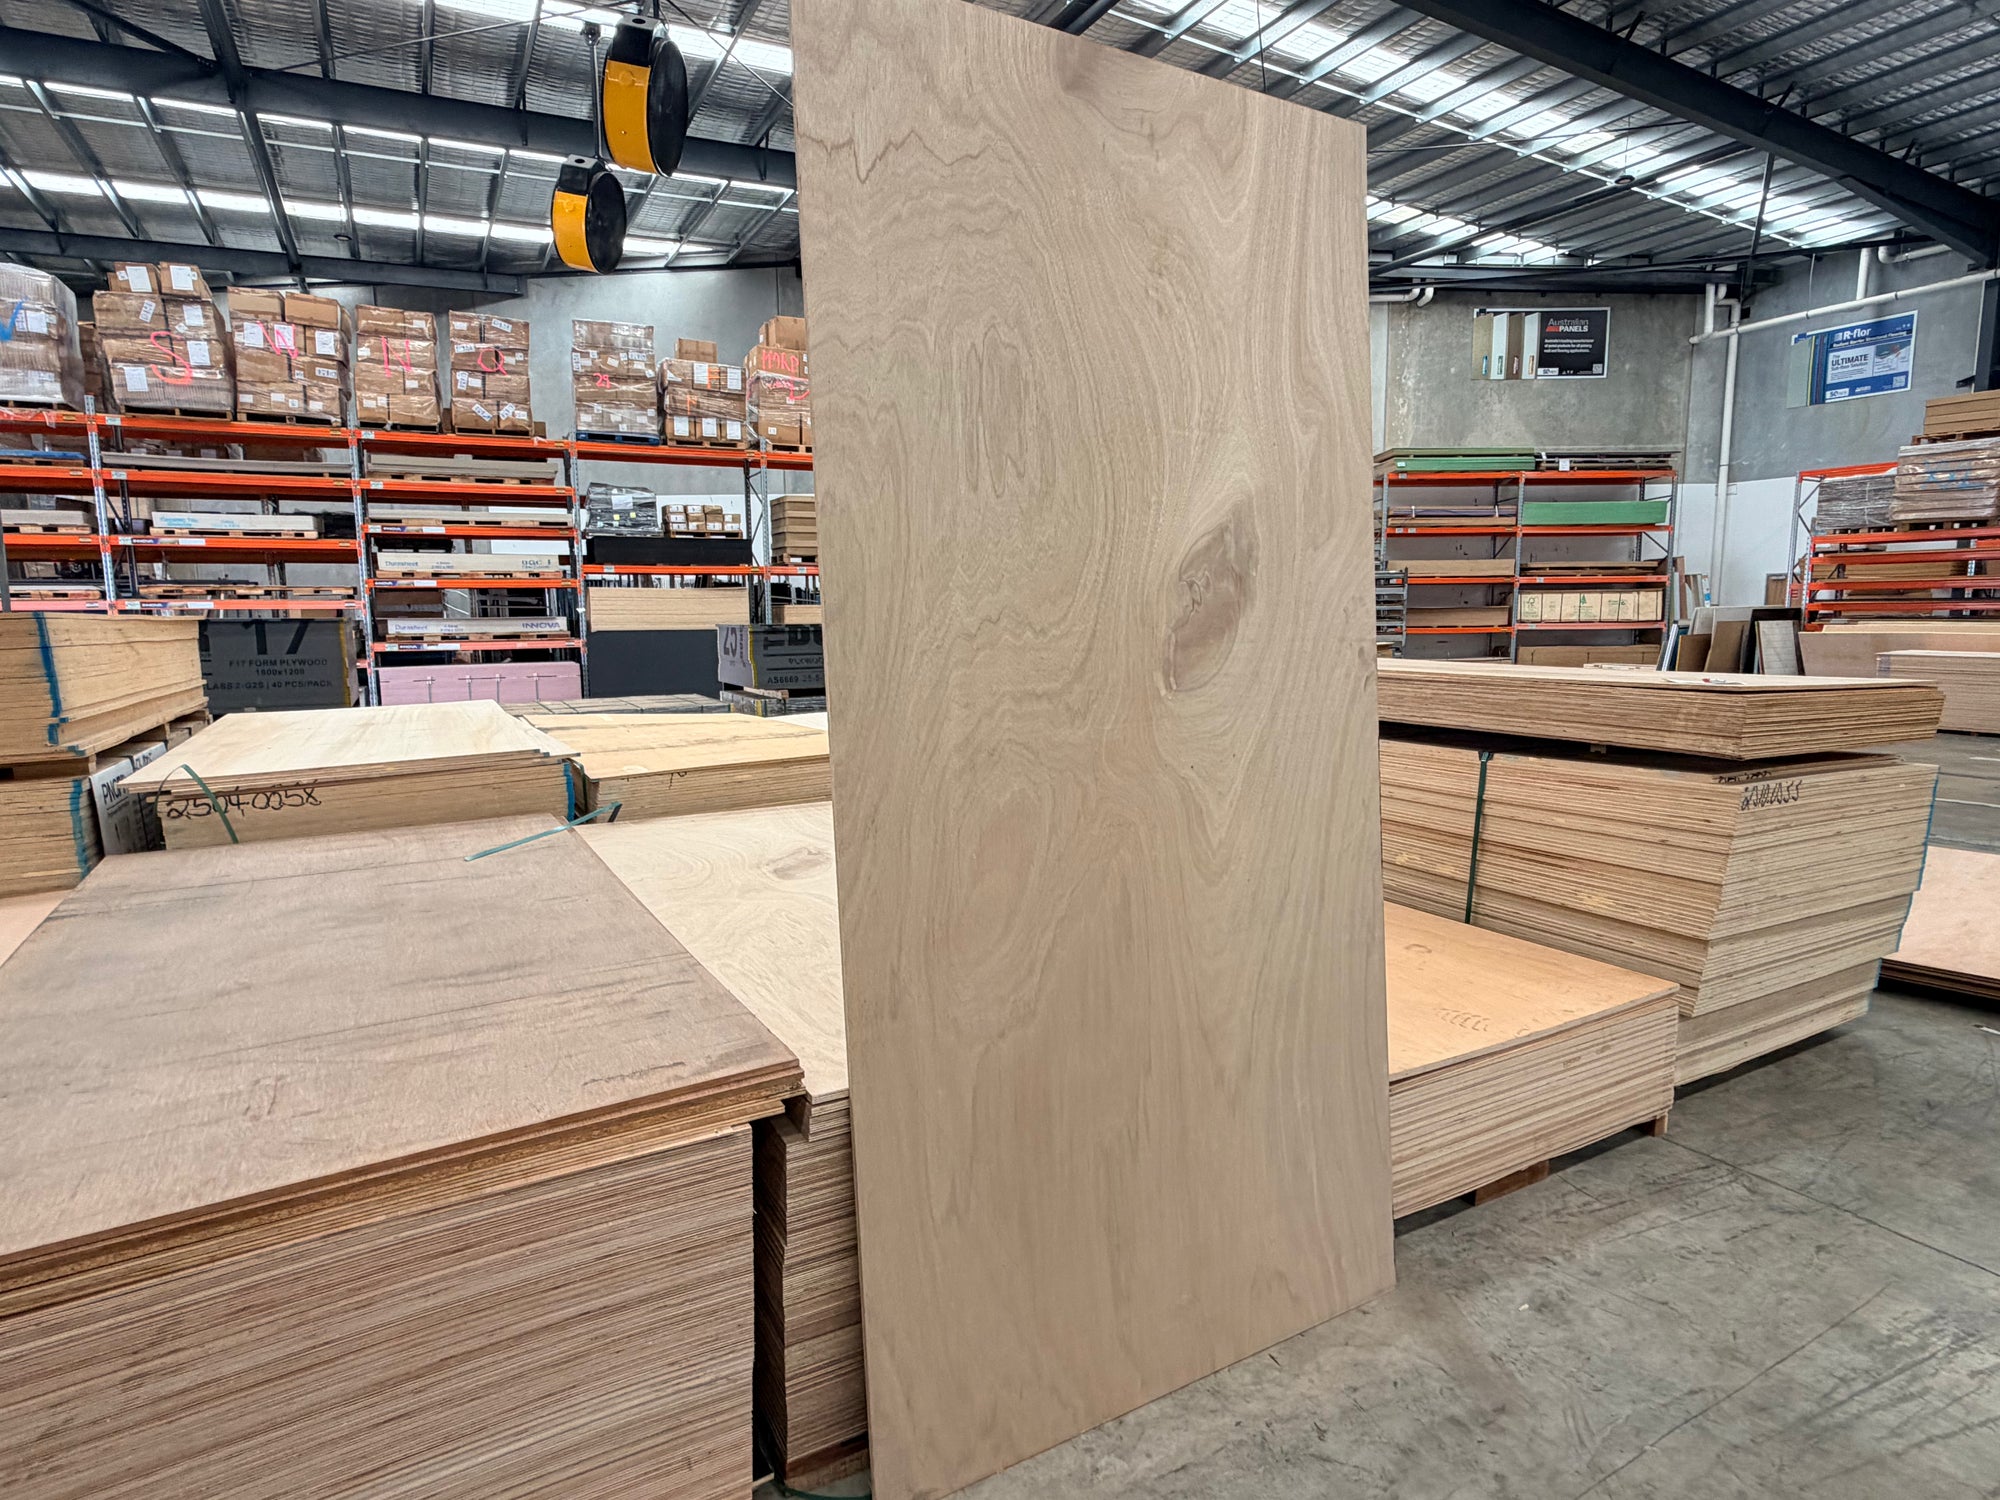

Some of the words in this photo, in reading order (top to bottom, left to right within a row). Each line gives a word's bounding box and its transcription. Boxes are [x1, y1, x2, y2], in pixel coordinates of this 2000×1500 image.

[1843, 328, 1872, 341] R-flor
[1831, 353, 1869, 367] ULTIMATE
[249, 659, 278, 667] FORM
[280, 658, 328, 666] PLYWOOD
